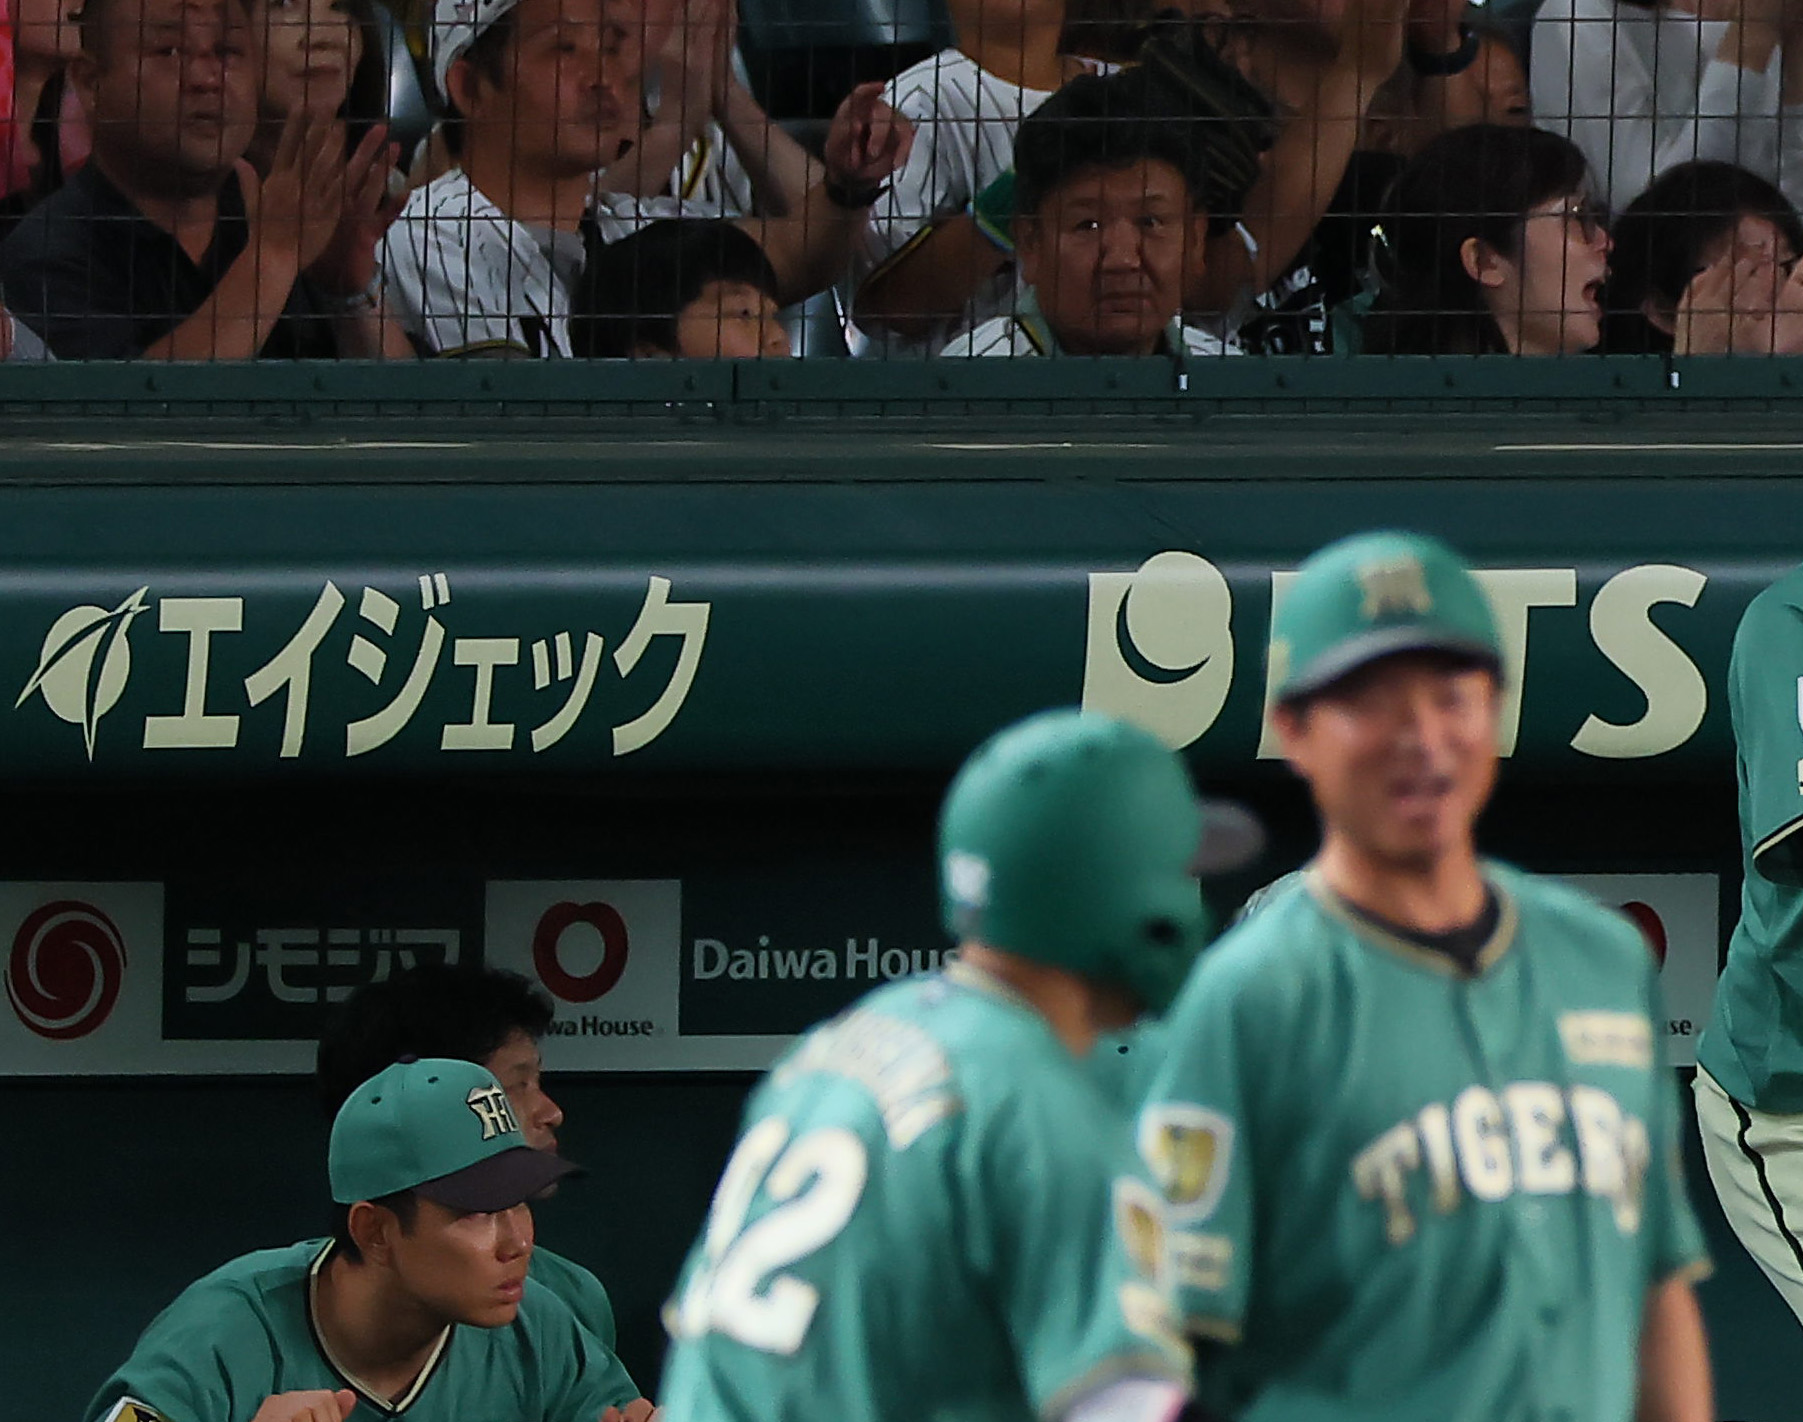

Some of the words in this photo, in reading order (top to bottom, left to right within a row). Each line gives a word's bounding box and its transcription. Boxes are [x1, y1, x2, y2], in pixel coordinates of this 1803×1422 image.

[142, 572, 711, 758] エイジェック
[1256, 564, 1708, 759] TS
[693, 936, 836, 980] Daiwa
